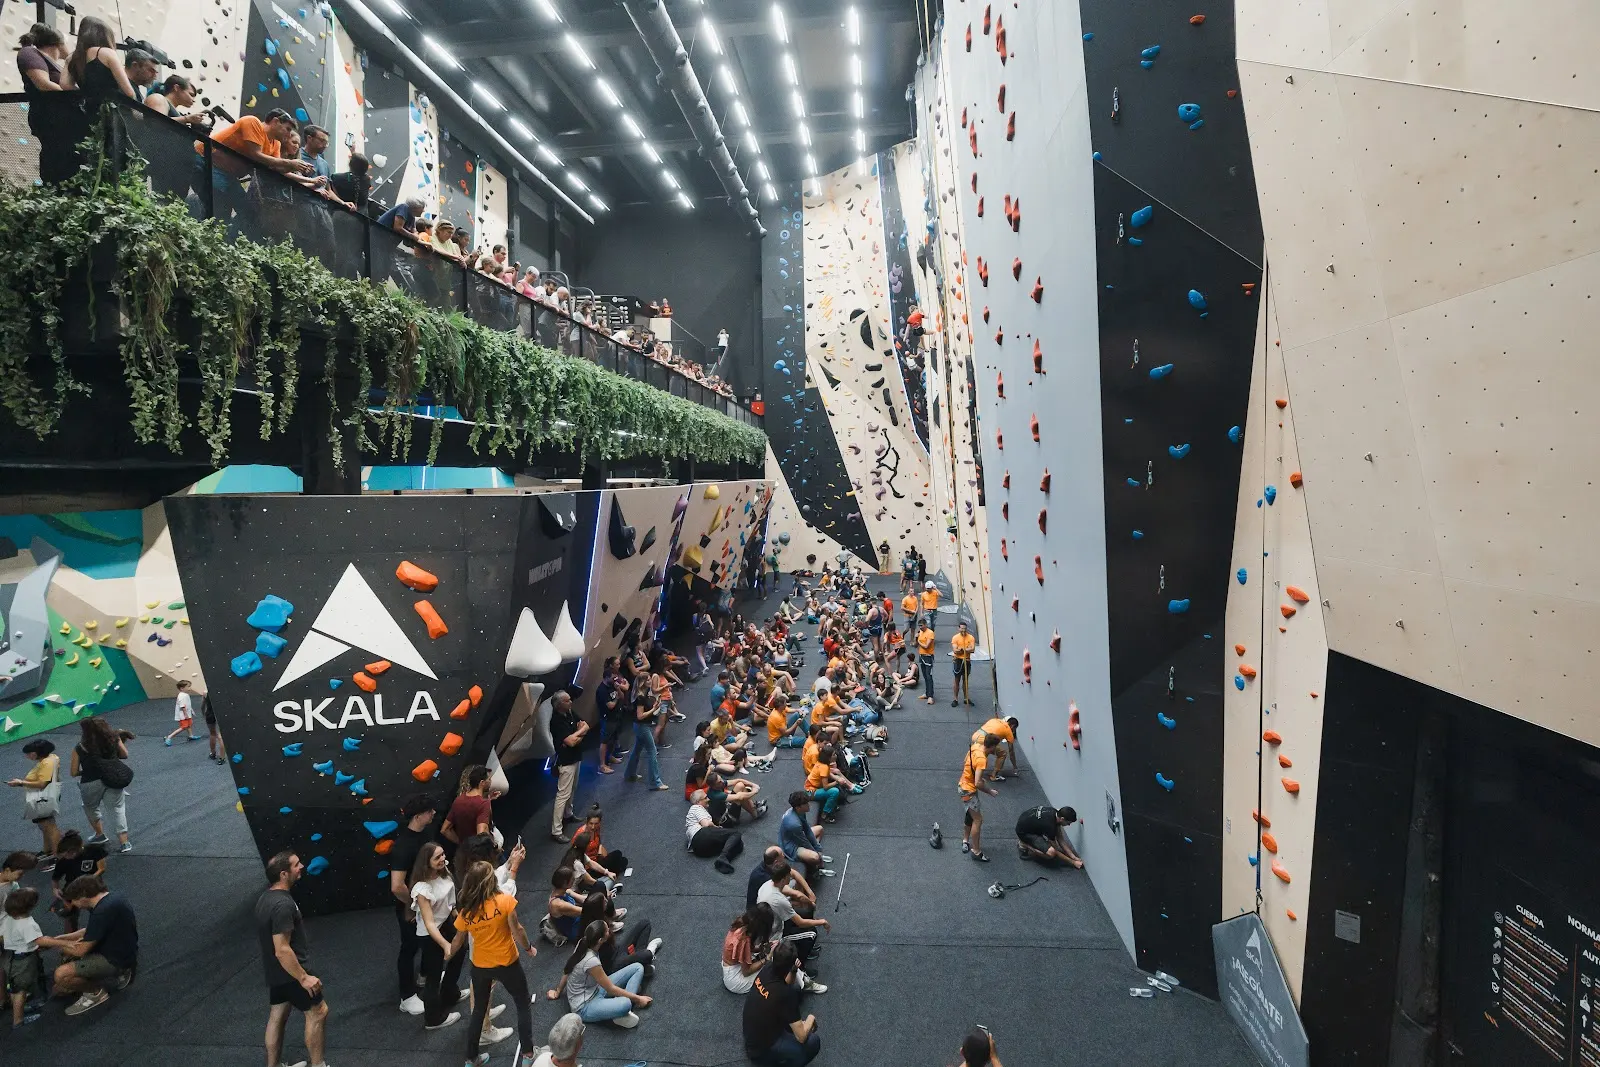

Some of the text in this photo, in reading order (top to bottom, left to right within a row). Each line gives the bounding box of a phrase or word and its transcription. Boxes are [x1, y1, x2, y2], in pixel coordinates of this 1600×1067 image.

[273, 690, 441, 733] SKALA
[464, 908, 502, 926] SKALA
[1516, 904, 1545, 929] CUERDA
[1246, 949, 1264, 977] SKA
[1582, 949, 1600, 966] AUT
